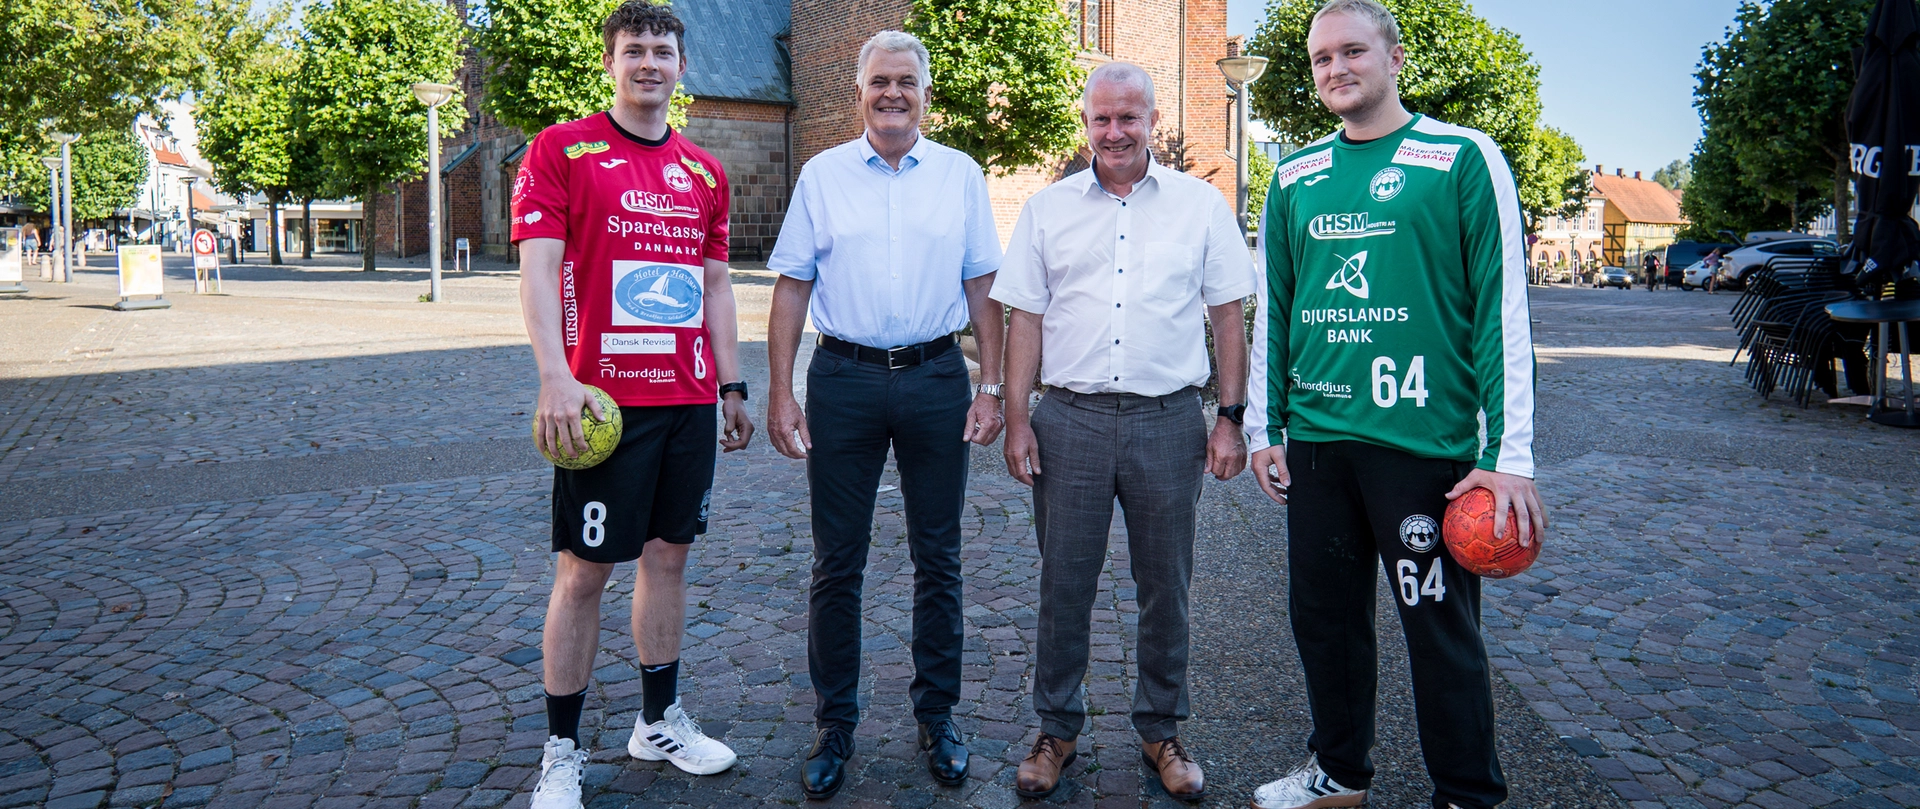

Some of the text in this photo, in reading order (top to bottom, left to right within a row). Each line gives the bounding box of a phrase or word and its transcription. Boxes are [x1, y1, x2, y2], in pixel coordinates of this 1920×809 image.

[1397, 150, 1454, 163] TIPSMARK
[632, 190, 674, 211] HSM
[1319, 211, 1369, 233] HSM
[634, 242, 698, 256] DANMARK
[633, 267, 660, 281] Hotel
[563, 261, 579, 347] FAXE KONDI
[1301, 307, 1409, 326] DJURSLANDS
[612, 338, 676, 346] Dansk Revision
[1327, 329, 1373, 343] BANK
[693, 335, 707, 380] 8
[618, 368, 676, 380] norddjurs
[1371, 355, 1429, 408] 64
[1301, 381, 1352, 393] norddjurs
[582, 500, 607, 548] 8
[1396, 556, 1446, 607] 64
